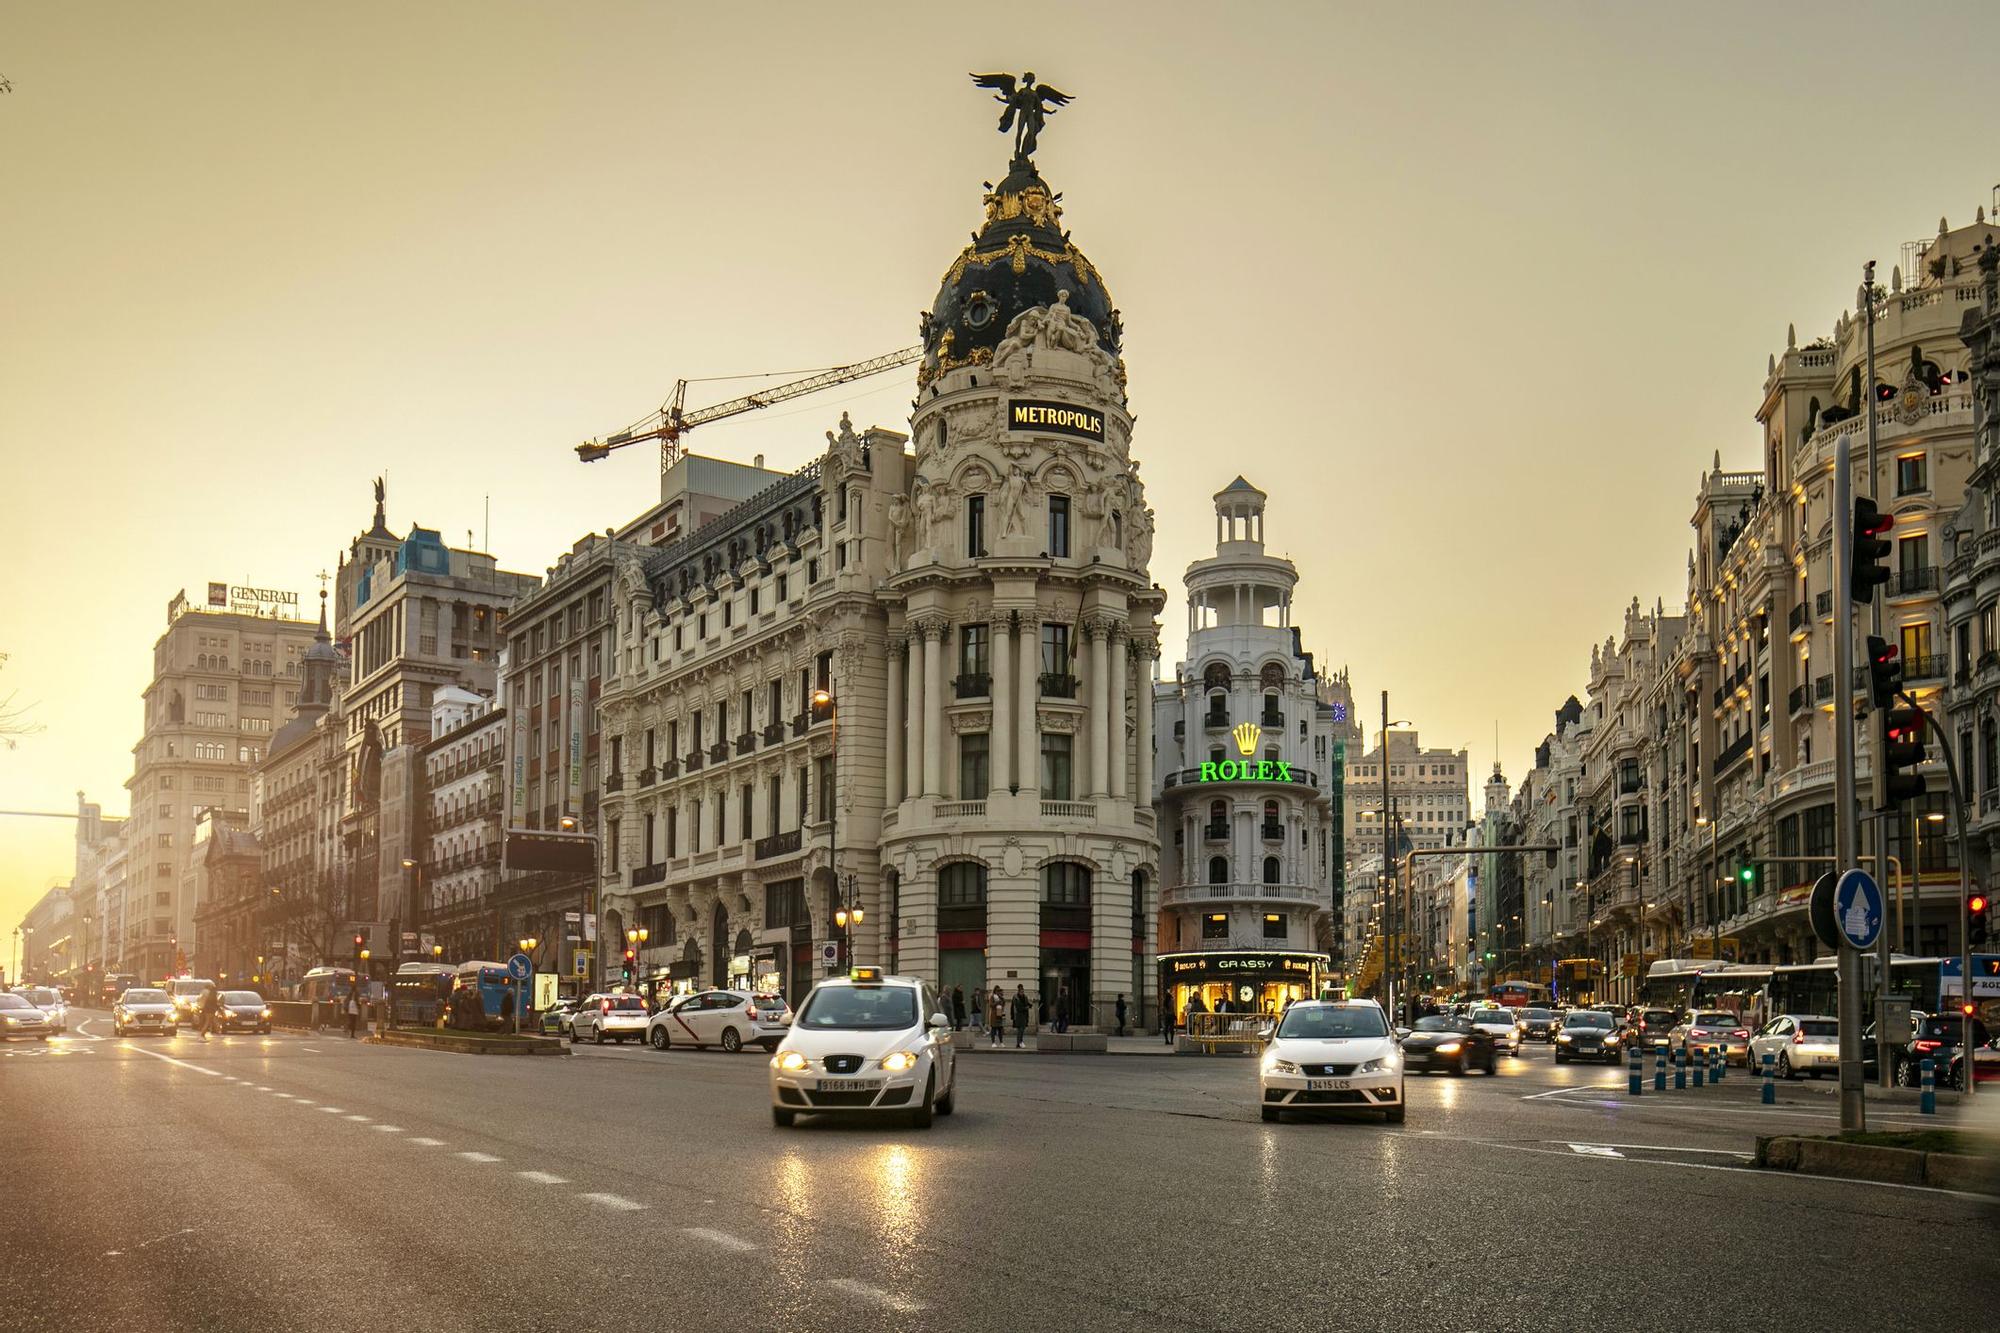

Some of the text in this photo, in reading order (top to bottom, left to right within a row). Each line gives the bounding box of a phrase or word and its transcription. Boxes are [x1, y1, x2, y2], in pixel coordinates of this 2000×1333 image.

[1015, 406, 1102, 434] METROPOLIS
[230, 586, 299, 605] GENERALI
[514, 755, 524, 807] hay salida
[1200, 760, 1293, 782] ROLEX
[1218, 960, 1274, 969] GRASSY
